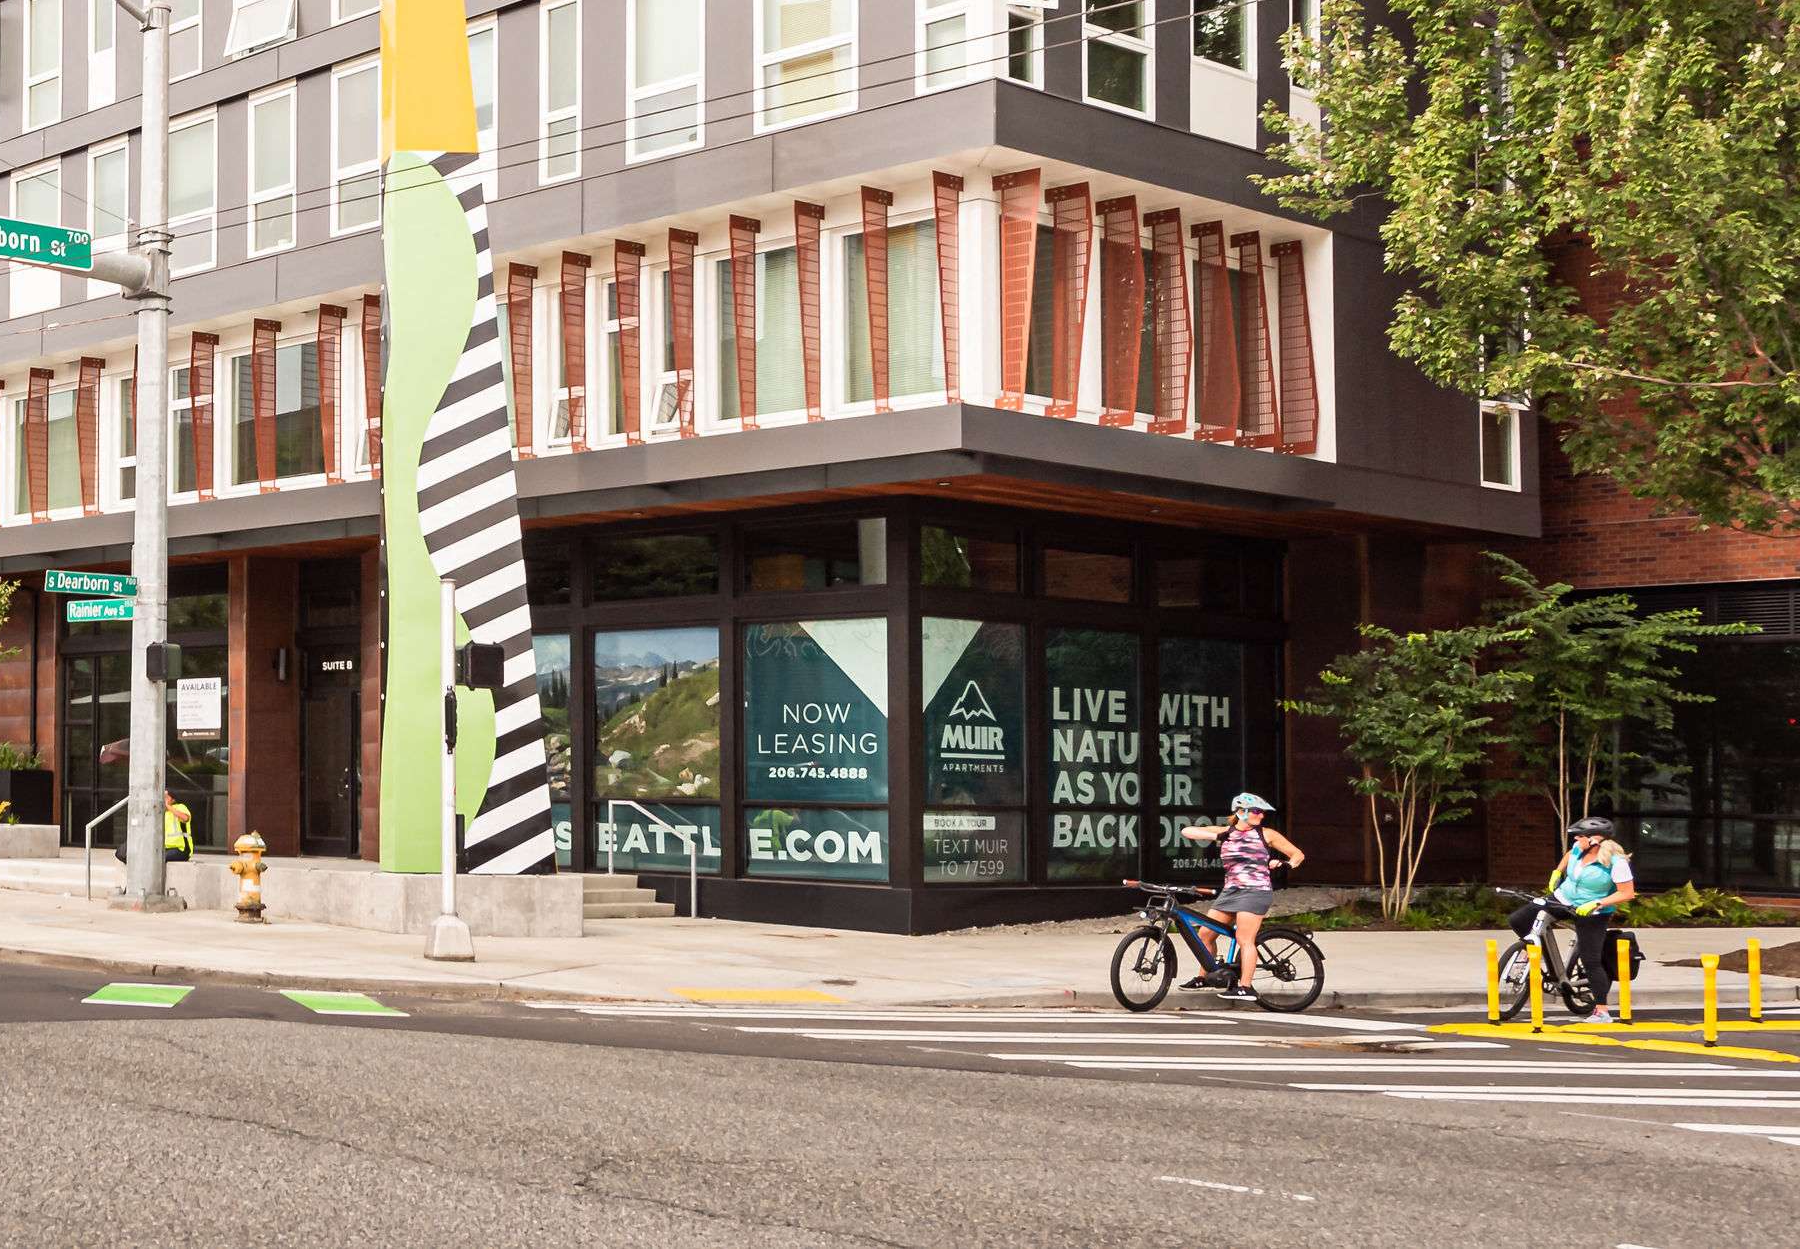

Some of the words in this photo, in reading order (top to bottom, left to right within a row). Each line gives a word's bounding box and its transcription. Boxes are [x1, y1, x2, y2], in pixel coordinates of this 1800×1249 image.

[50, 239, 66, 257] St
[66, 231, 88, 245] 700
[57, 573, 109, 591] Dearborn
[113, 580, 122, 592] St
[69, 603, 103, 618] Rainier
[104, 606, 118, 616] Ave
[119, 605, 125, 616] S
[322, 661, 345, 671] SUITE
[181, 682, 217, 691] AVAILABLE
[783, 703, 851, 724] NOW
[1053, 687, 1126, 723] LIVE
[1160, 693, 1230, 728] WITH
[758, 733, 878, 754] LEASING
[941, 724, 1004, 750] MUIR
[768, 767, 868, 779] 206.745.4888
[942, 763, 1004, 773] APARTMENTS
[1053, 770, 1096, 805] AS
[934, 839, 969, 854] TEXT
[975, 839, 1008, 854] MUIR
[939, 860, 959, 876] TO
[963, 860, 1005, 876] 77599
